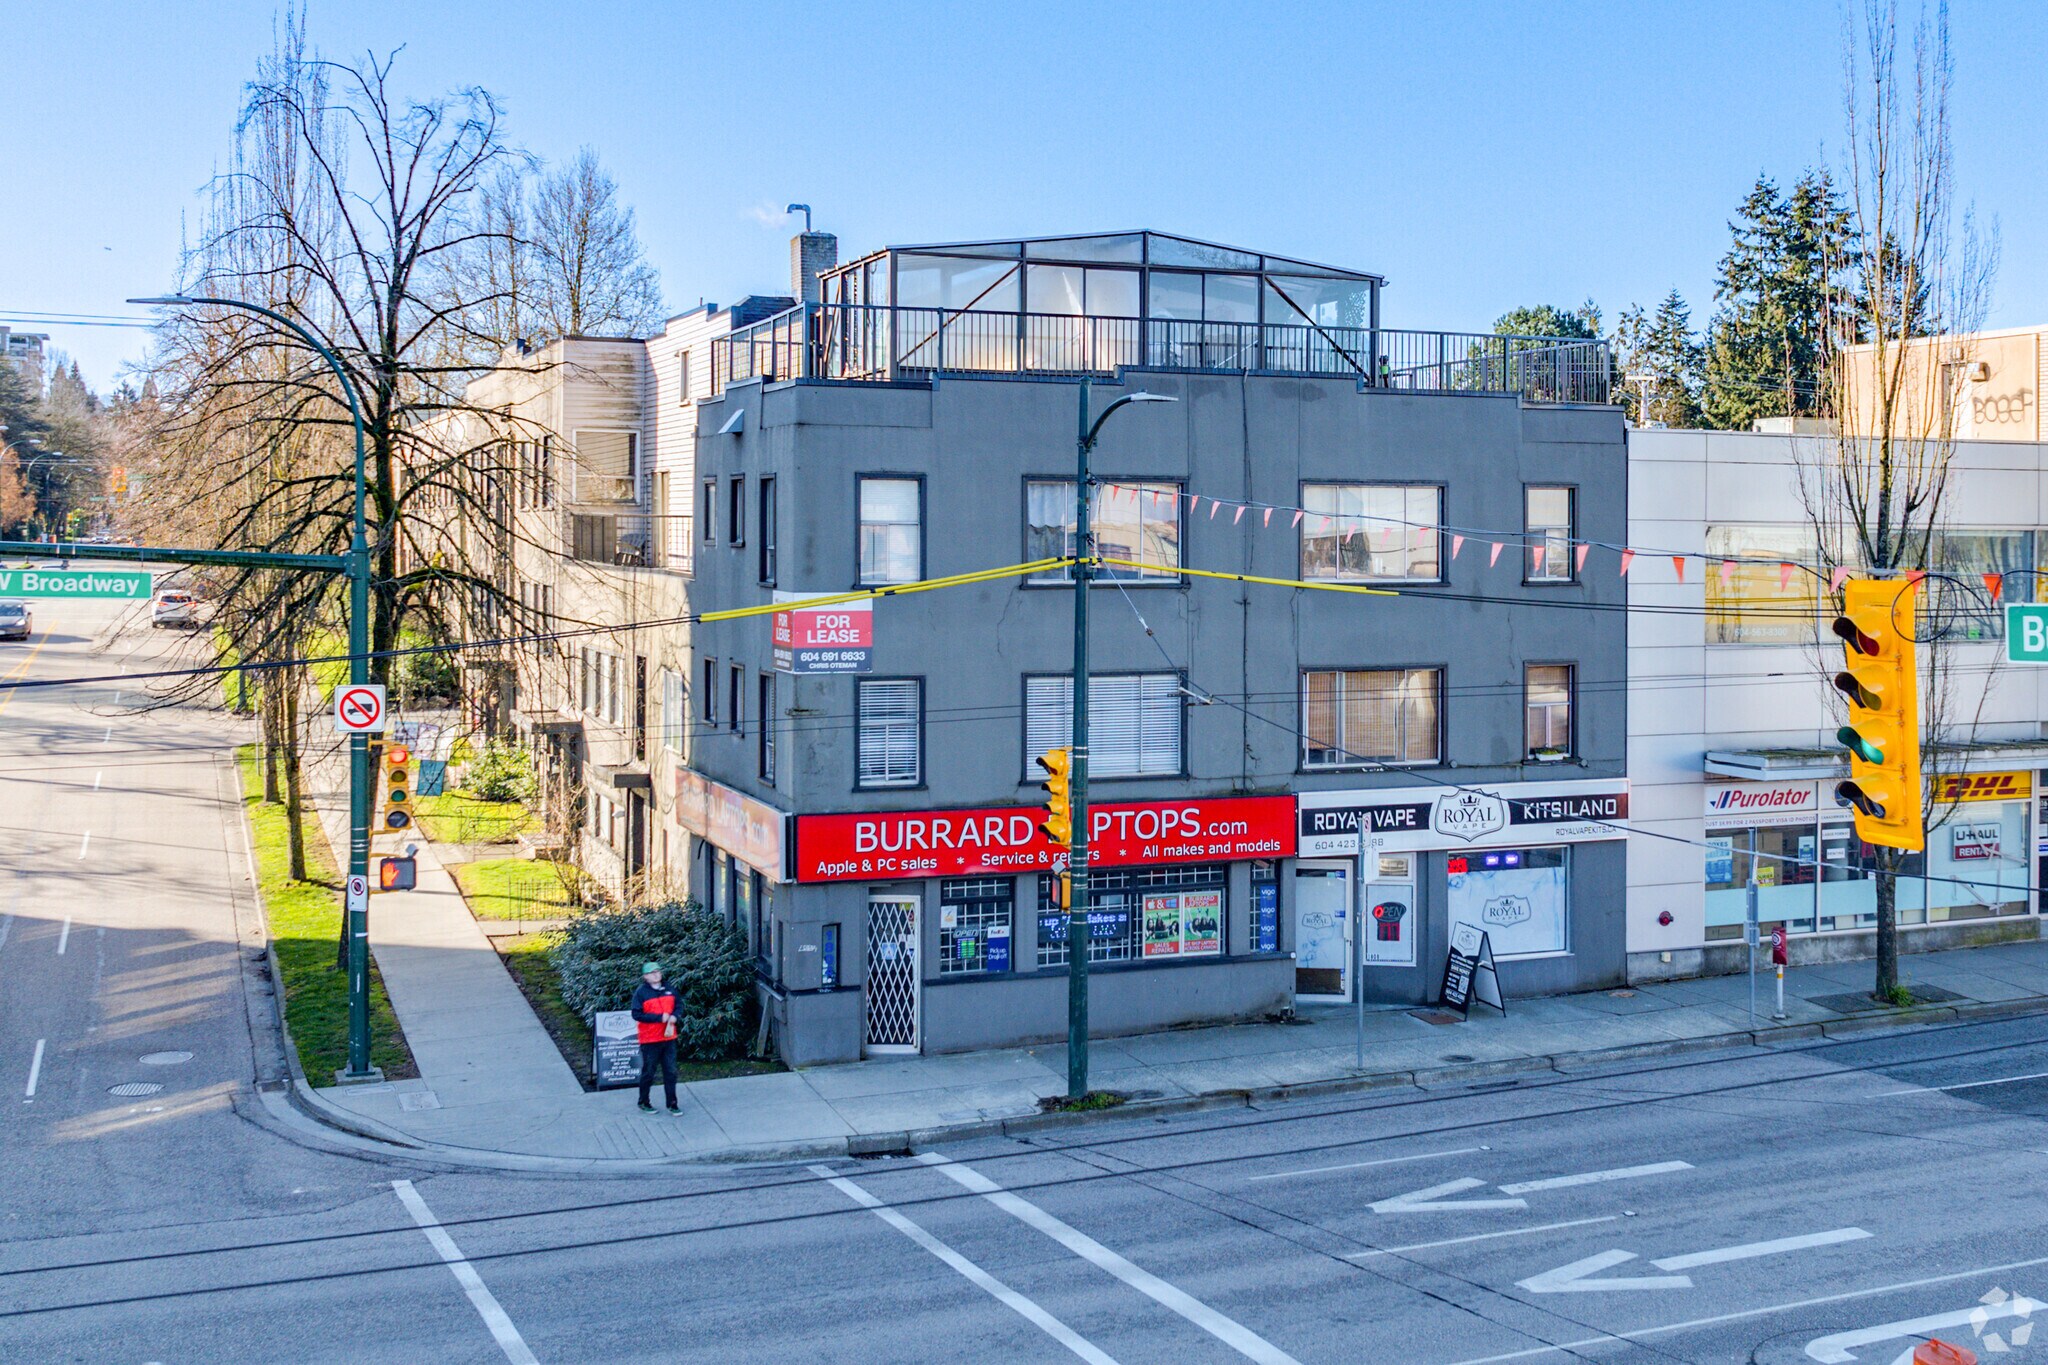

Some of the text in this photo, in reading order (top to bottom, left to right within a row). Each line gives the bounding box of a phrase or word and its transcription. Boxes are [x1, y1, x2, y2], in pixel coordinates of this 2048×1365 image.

[22, 573, 140, 596] Broadway
[777, 613, 788, 627] FOR
[816, 615, 850, 628] FOR
[775, 627, 791, 642] LEASE
[807, 630, 860, 643] LEASE
[2022, 615, 2048, 652] B
[800, 651, 866, 661] 604 691 6633
[1945, 775, 2018, 798] DHL
[1728, 788, 1811, 809] Purolator
[1314, 808, 1416, 831] ROYA VAPE
[1443, 806, 1497, 824] ROYAL
[855, 807, 1248, 853] BURRARD PTOPS.com
[1453, 822, 1487, 830] VAPE
[1956, 829, 1998, 840] U-HAUL
[1315, 841, 1334, 850] 604
[1337, 840, 1356, 848] 423
[816, 838, 1281, 877] Apple & PC sales Service & rers All makes and models
[1373, 904, 1403, 919] OPEN
[1489, 905, 1525, 917] ROYAL
[955, 929, 978, 937] OPEN
